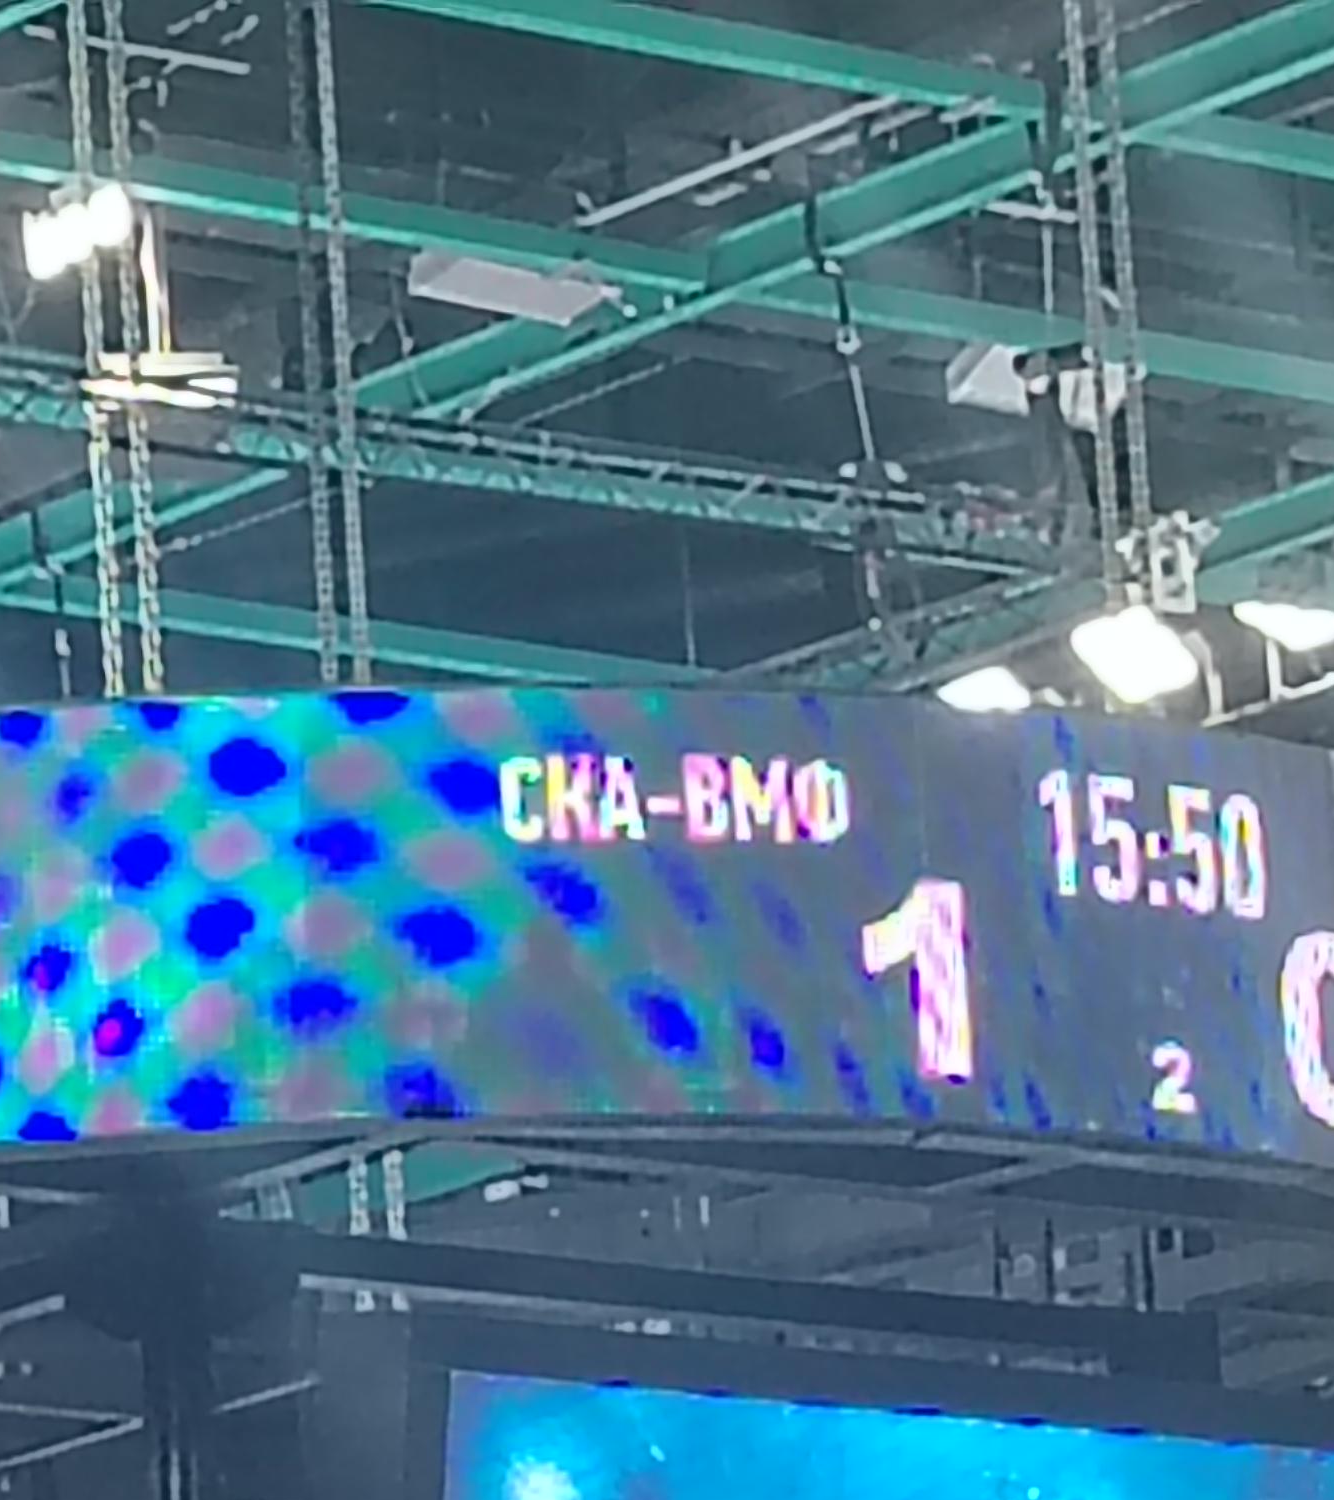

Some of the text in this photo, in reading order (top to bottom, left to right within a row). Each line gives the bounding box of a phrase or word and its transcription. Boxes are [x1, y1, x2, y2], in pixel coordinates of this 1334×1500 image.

[499, 753, 851, 844] СКА-ВМФ
[1039, 768, 1267, 921] 15:50
[862, 879, 974, 1083] 1
[1149, 1042, 1198, 1113] 2
